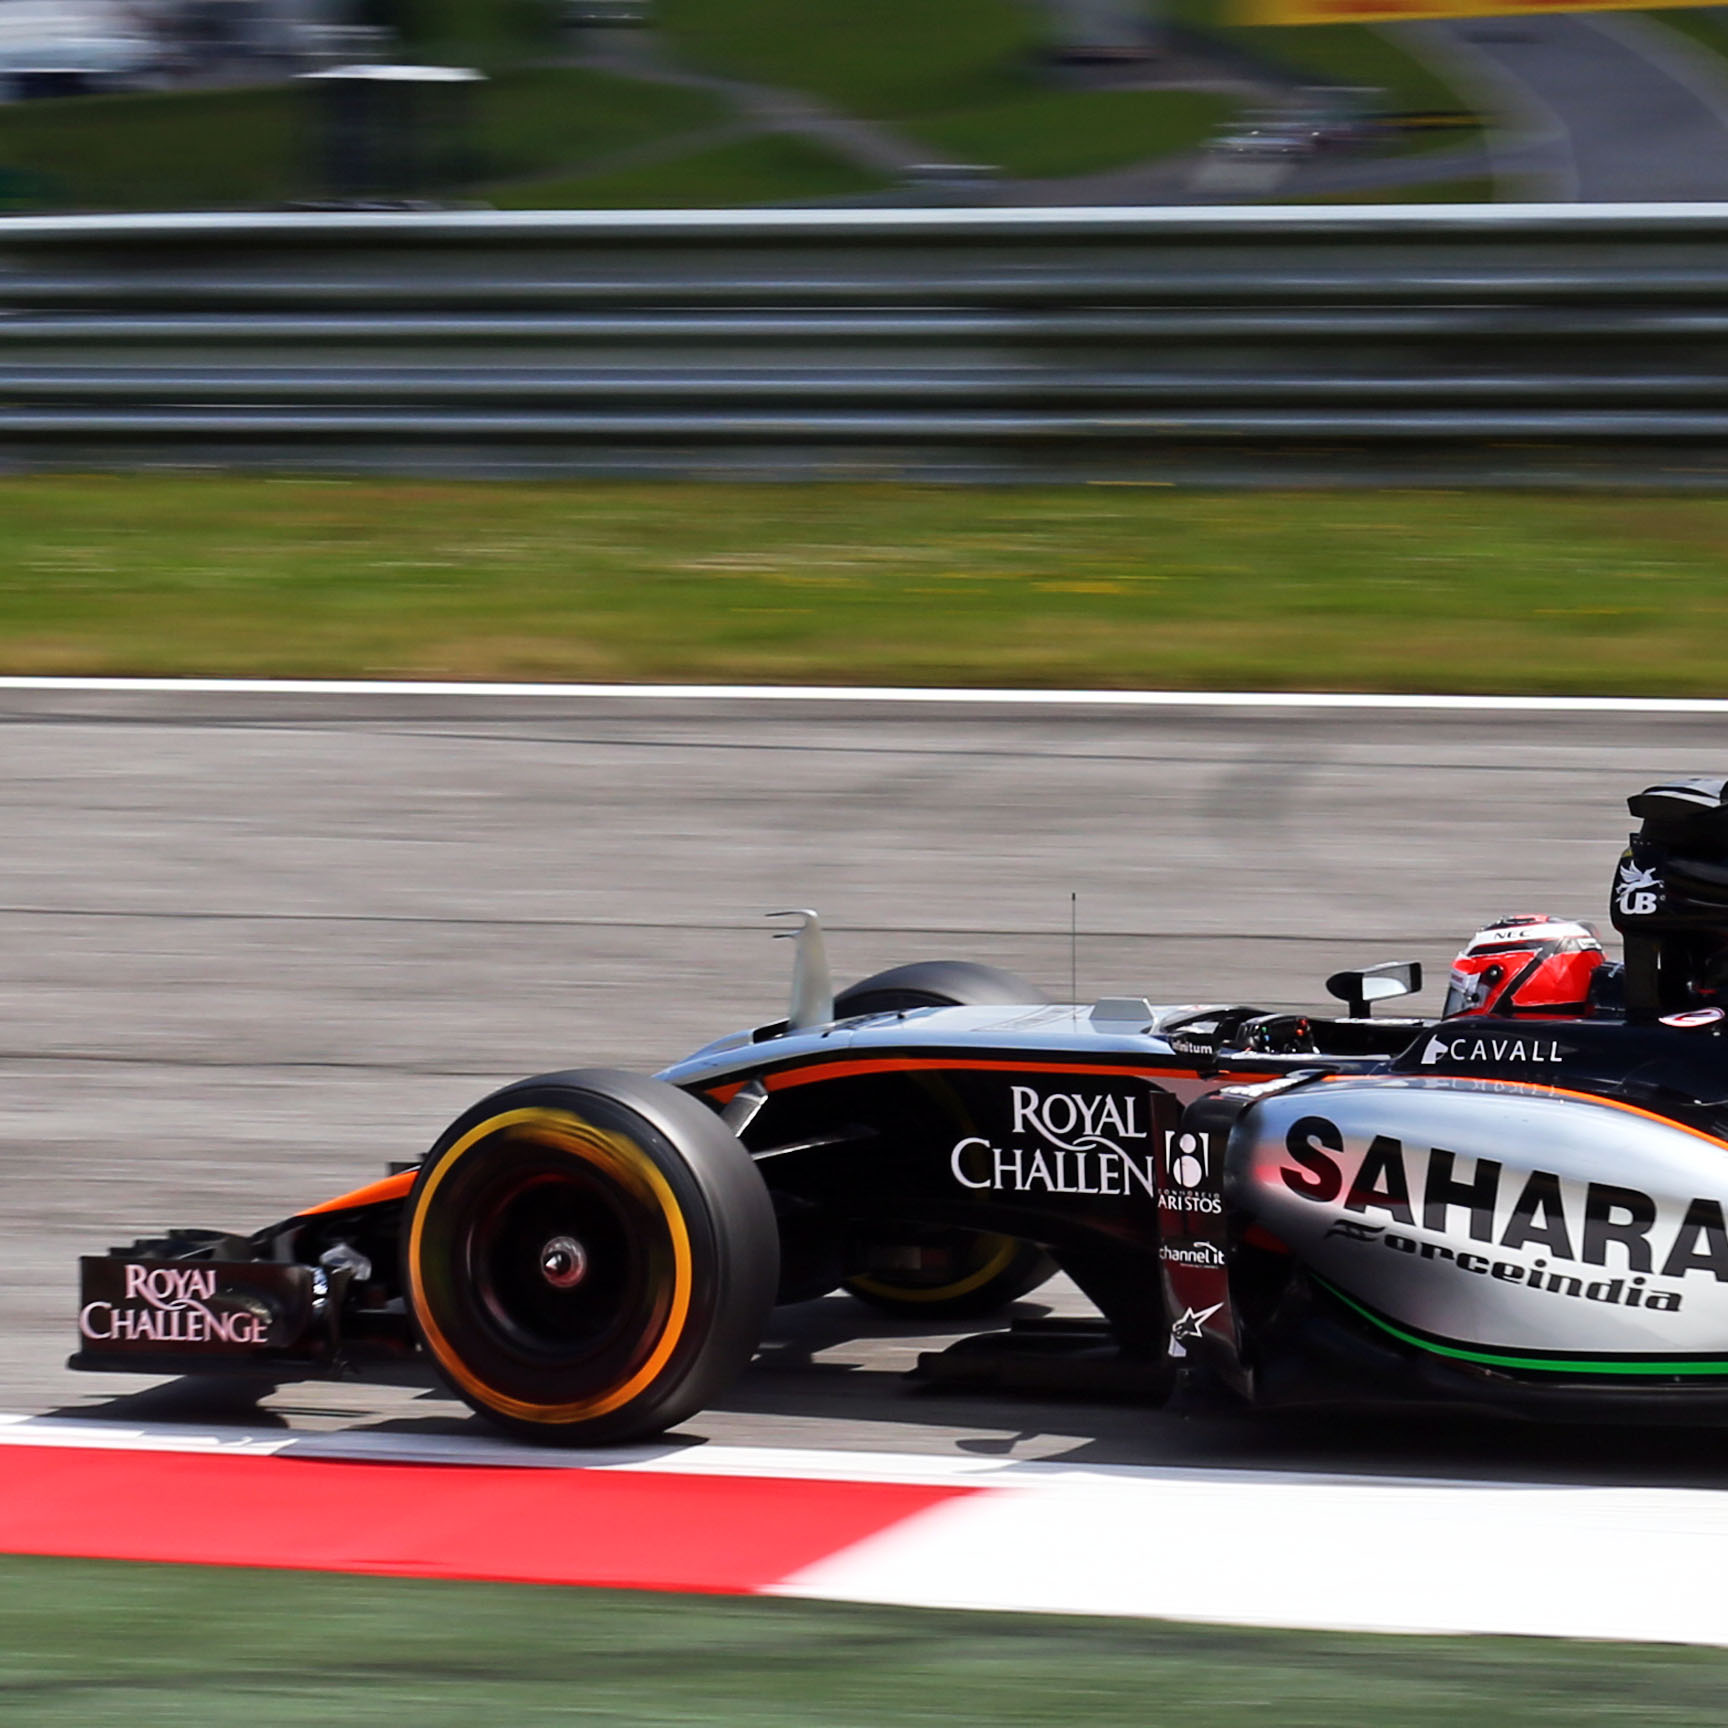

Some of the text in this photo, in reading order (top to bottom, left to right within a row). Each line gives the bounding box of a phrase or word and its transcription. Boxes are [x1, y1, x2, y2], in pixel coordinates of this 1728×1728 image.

[1619, 891, 1658, 915] UB
[1450, 1038, 1563, 1062] CAVALL
[1011, 1085, 1147, 1151] ROYAL
[1157, 1193, 1223, 1214] ARISTOS
[1159, 1244, 1226, 1265] channel it
[79, 1300, 269, 1343] CHALLENGE
